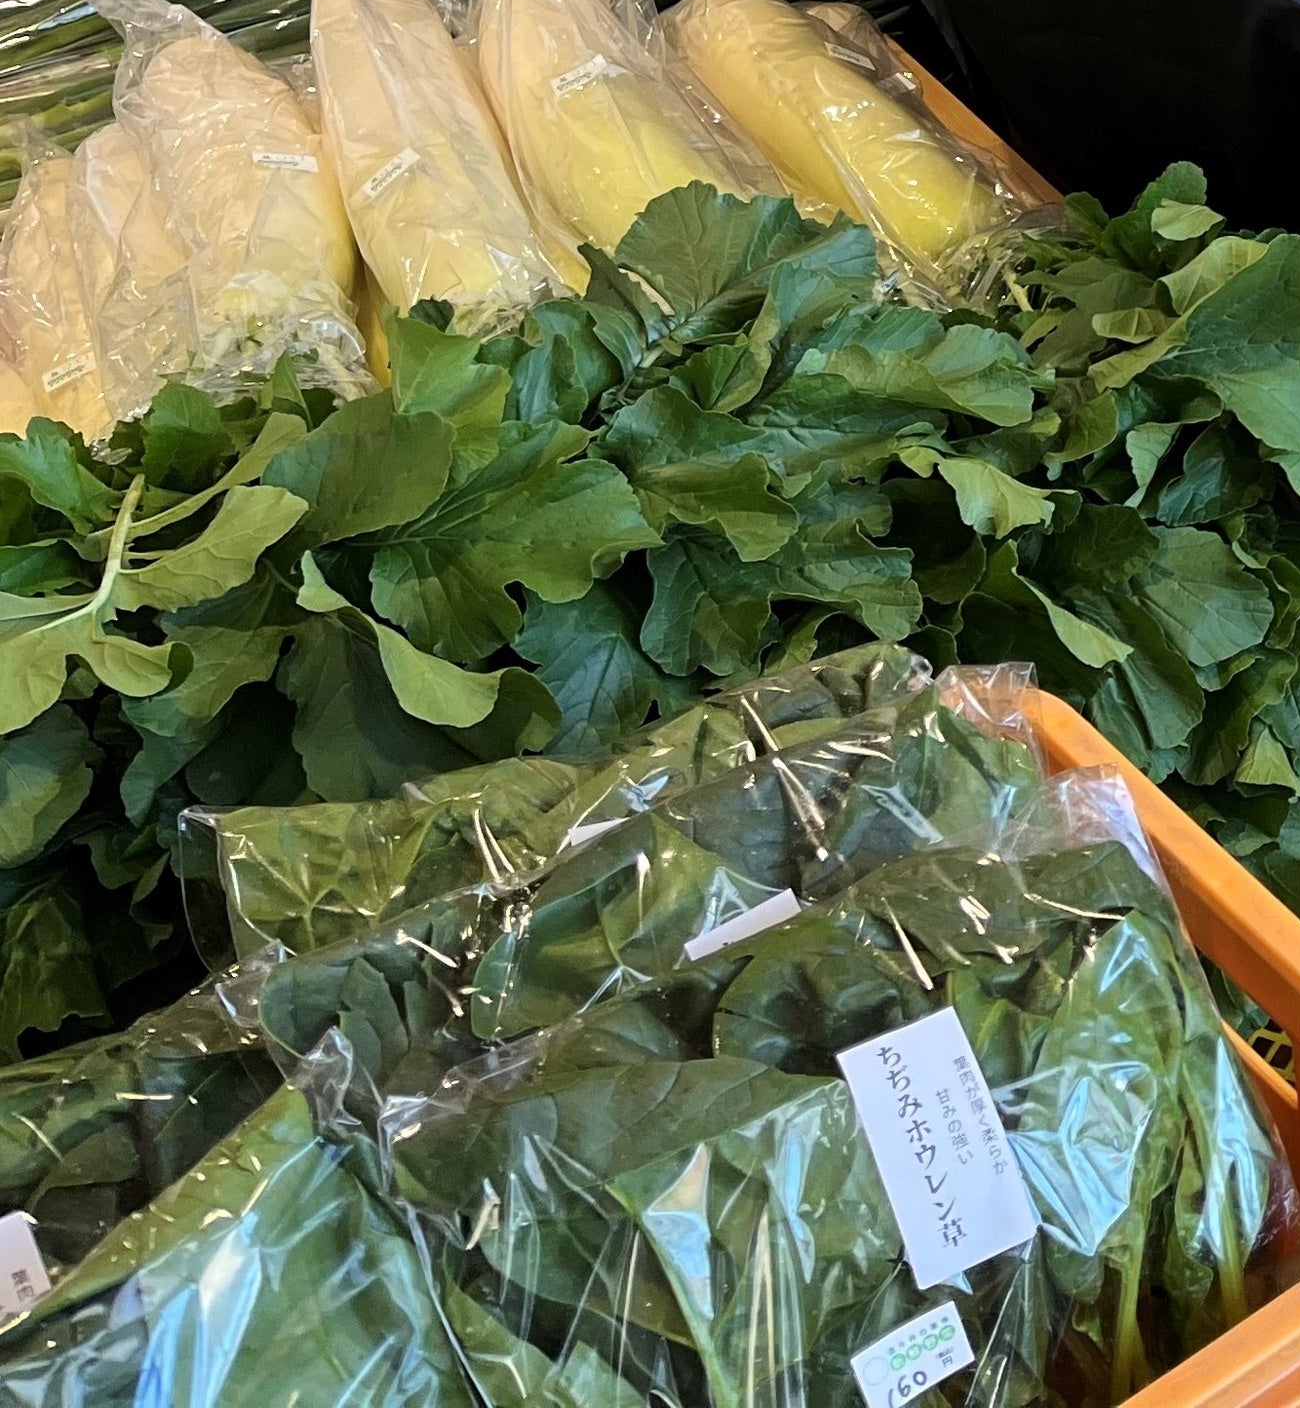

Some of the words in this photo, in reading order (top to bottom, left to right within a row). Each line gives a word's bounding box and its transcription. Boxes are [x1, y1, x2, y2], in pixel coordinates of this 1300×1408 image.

[876, 1045, 967, 1248] ちぢみホウレン草
